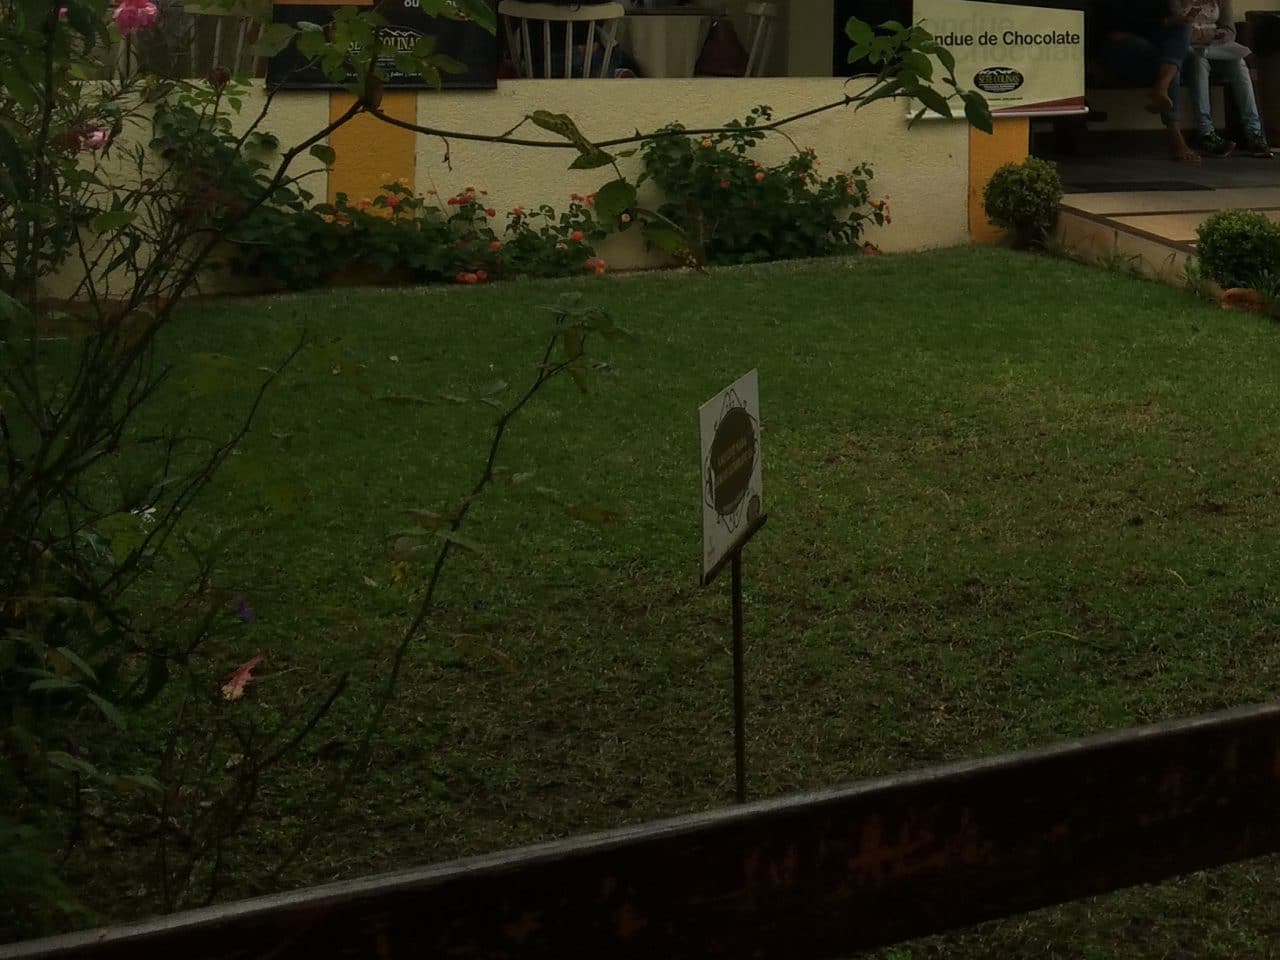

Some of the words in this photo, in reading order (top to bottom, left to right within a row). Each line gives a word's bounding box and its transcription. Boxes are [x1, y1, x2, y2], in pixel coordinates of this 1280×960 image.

[934, 31, 973, 46] ndue
[978, 31, 998, 46] de
[1002, 30, 1081, 46] Chocolate
